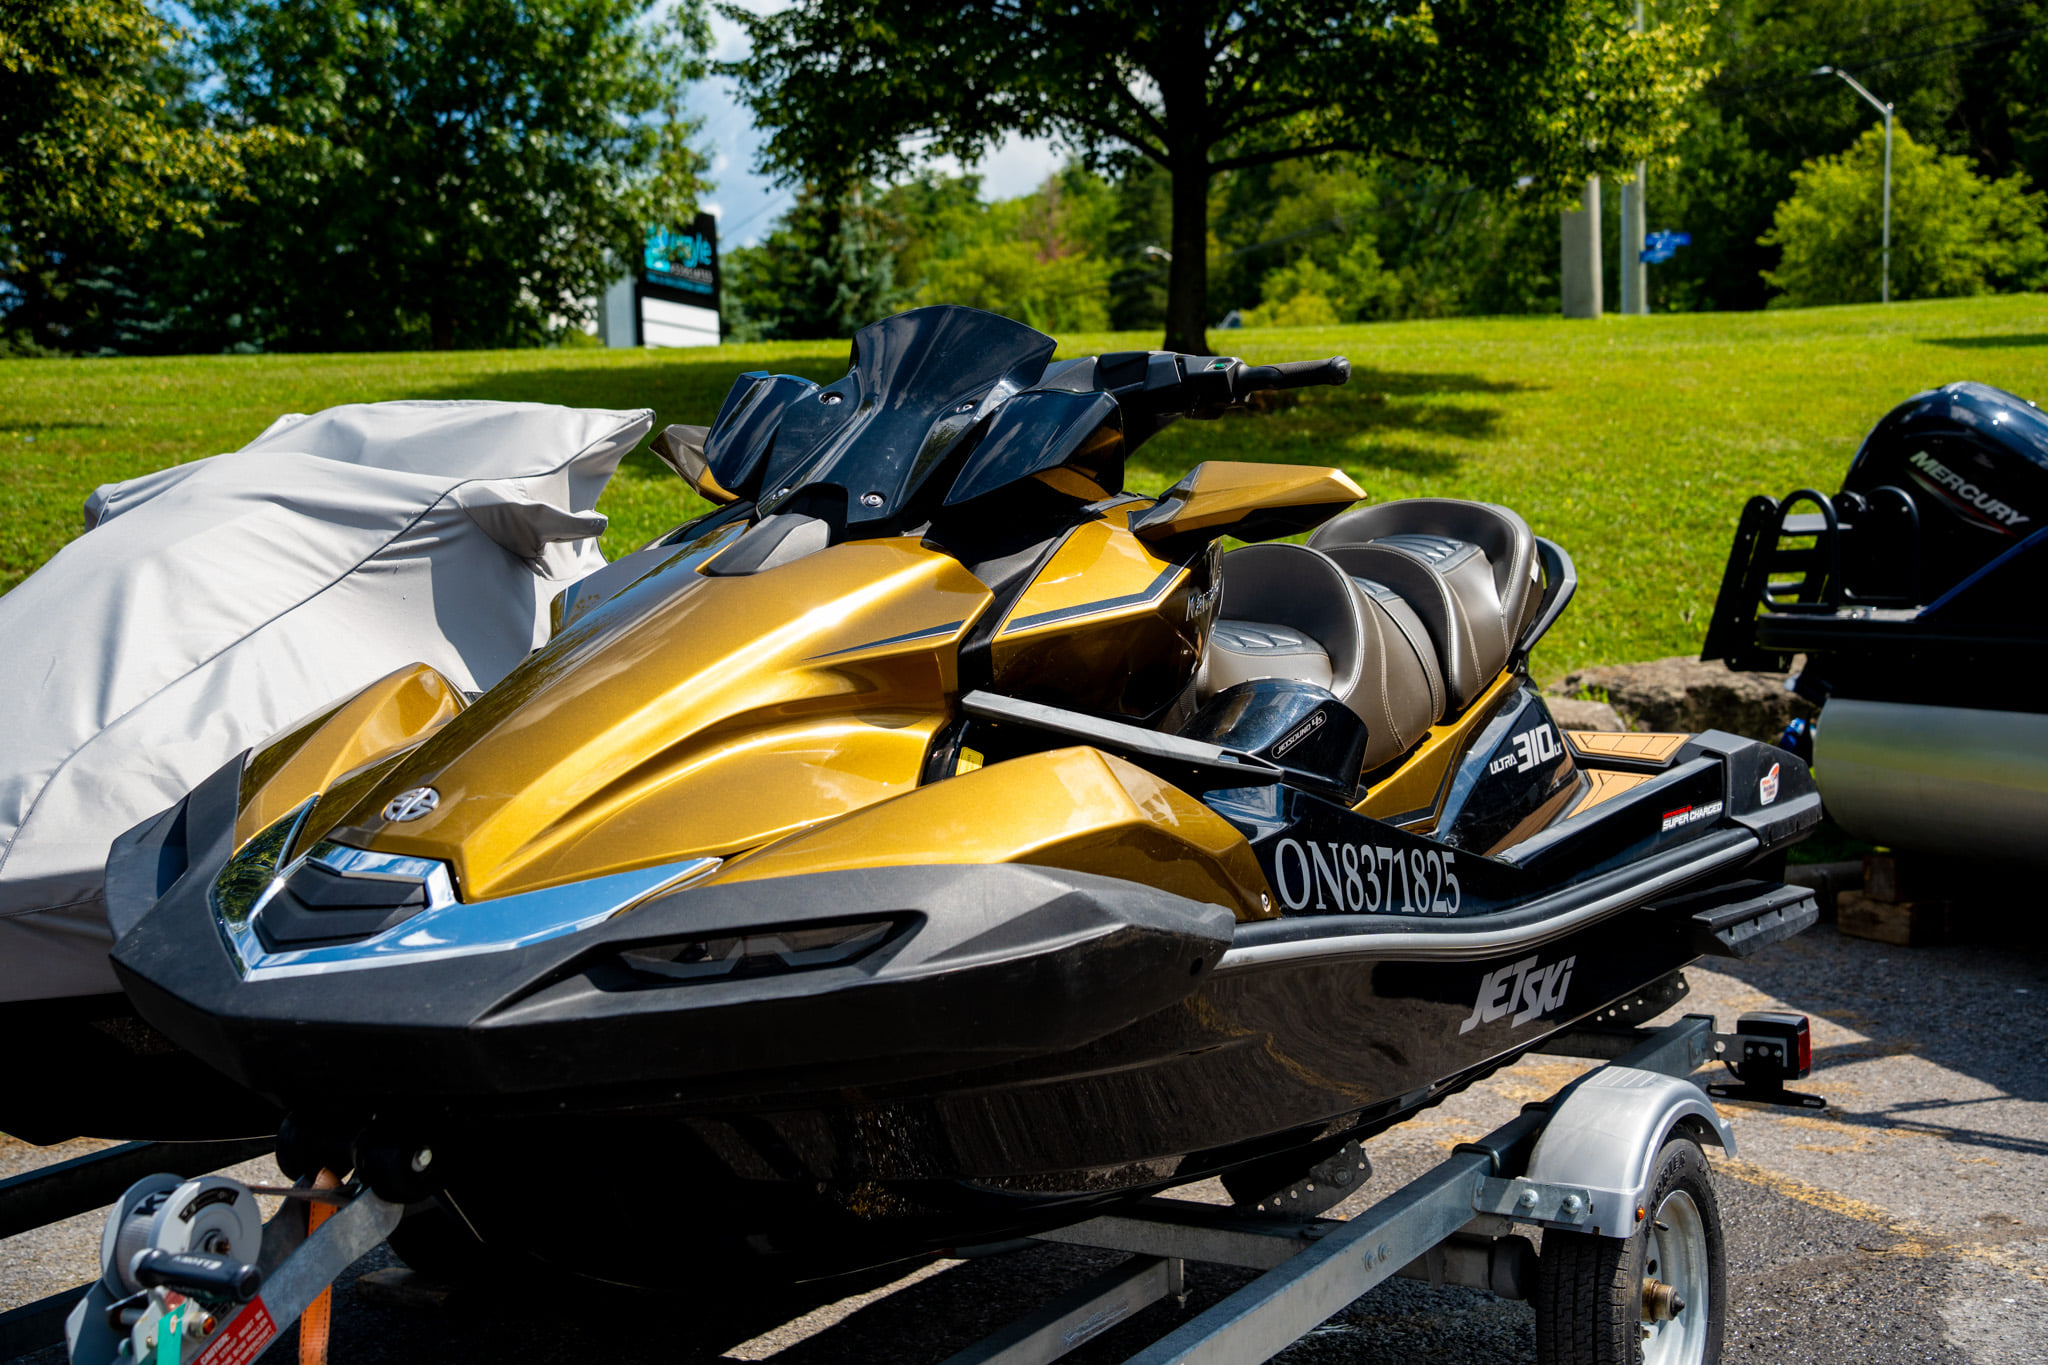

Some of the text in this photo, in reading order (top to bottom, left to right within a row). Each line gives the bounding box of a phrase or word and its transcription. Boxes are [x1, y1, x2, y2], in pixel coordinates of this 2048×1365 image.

[1909, 450, 2030, 526] MERCURY
[1277, 723, 1311, 754] JETSOUND
[1489, 753, 1518, 775] ULTRA
[1512, 723, 1555, 773] 310
[1661, 812, 1689, 832] SUPER
[1689, 800, 1723, 821] CHARGED
[1275, 838, 1461, 914] ON8371825
